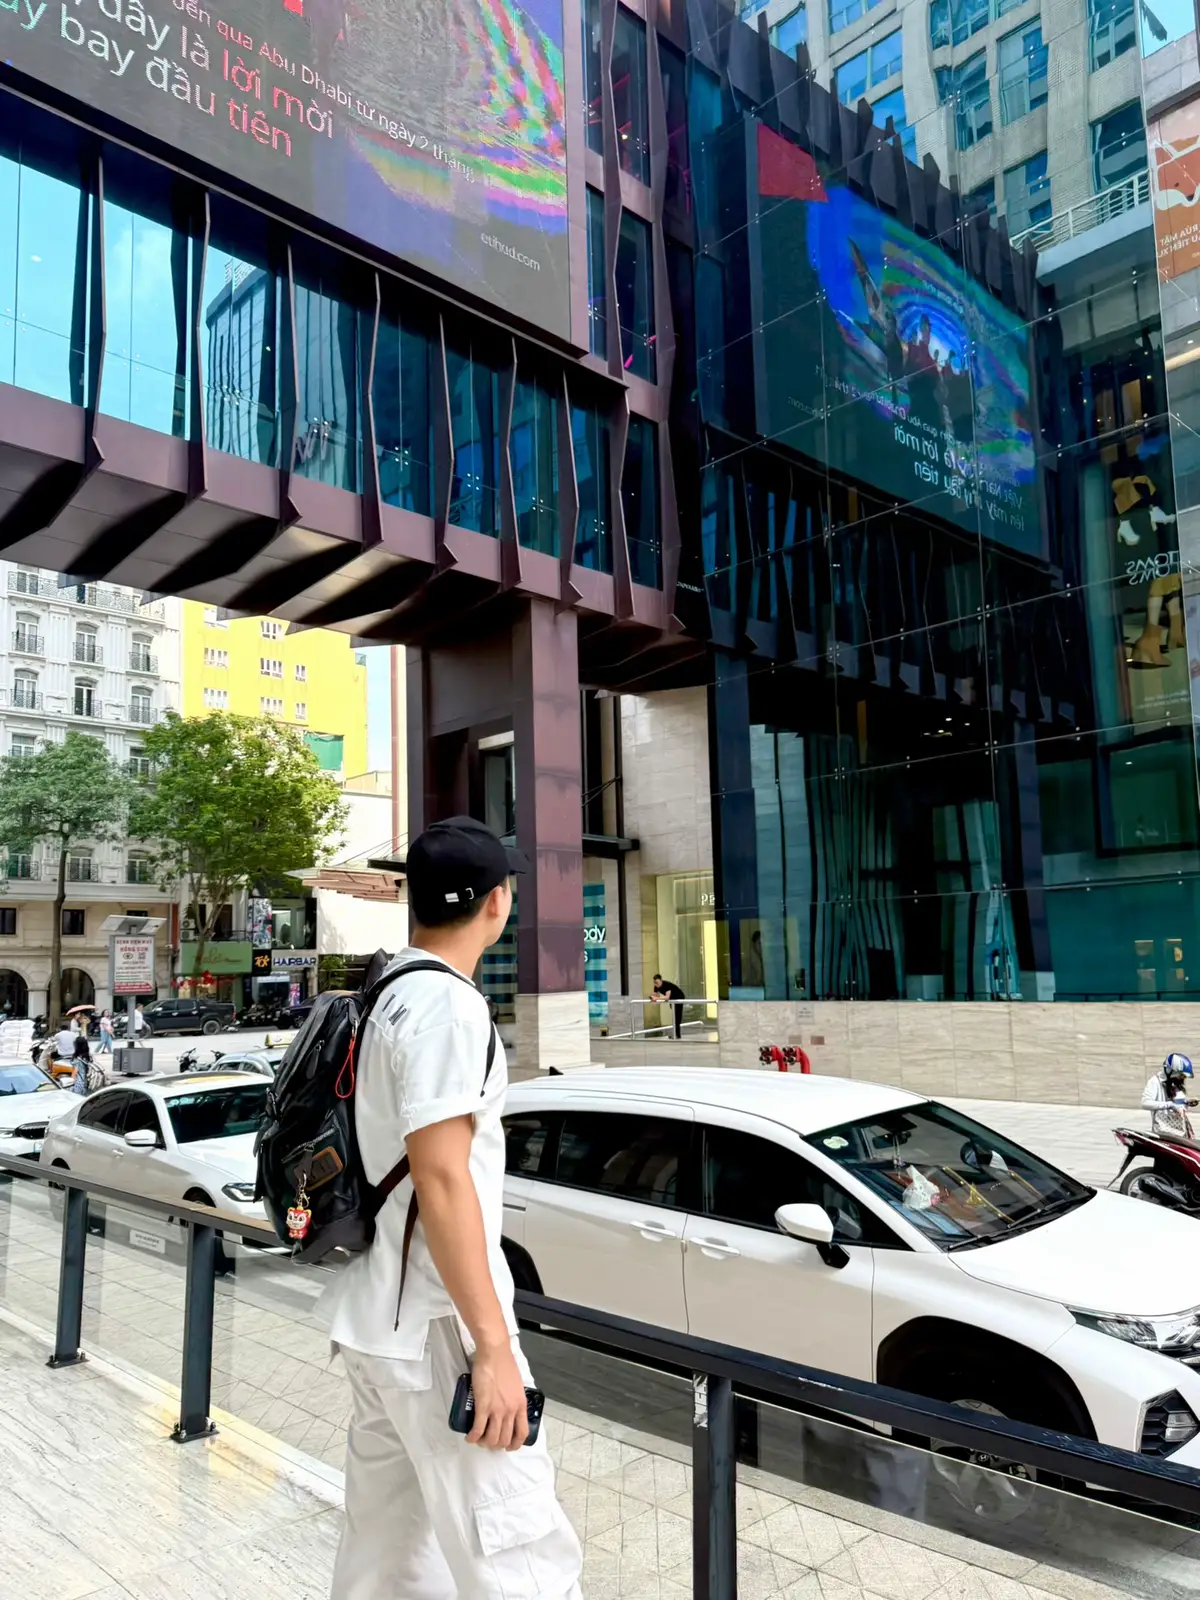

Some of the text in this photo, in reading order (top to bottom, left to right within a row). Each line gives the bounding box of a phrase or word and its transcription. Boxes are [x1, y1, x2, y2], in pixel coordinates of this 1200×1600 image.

[60, 2, 135, 77] bay
[145, 55, 216, 117] đầu
[226, 97, 292, 158] tiên
[181, 25, 210, 71] là
[222, 48, 261, 100] lời
[272, 85, 334, 139] mời
[216, 20, 253, 51] qua
[258, 42, 296, 76] Abu
[301, 64, 352, 109] Dhabi
[355, 98, 375, 122] từ
[378, 111, 417, 148] ngày
[419, 135, 429, 149] 2
[584, 924, 606, 944] ody
